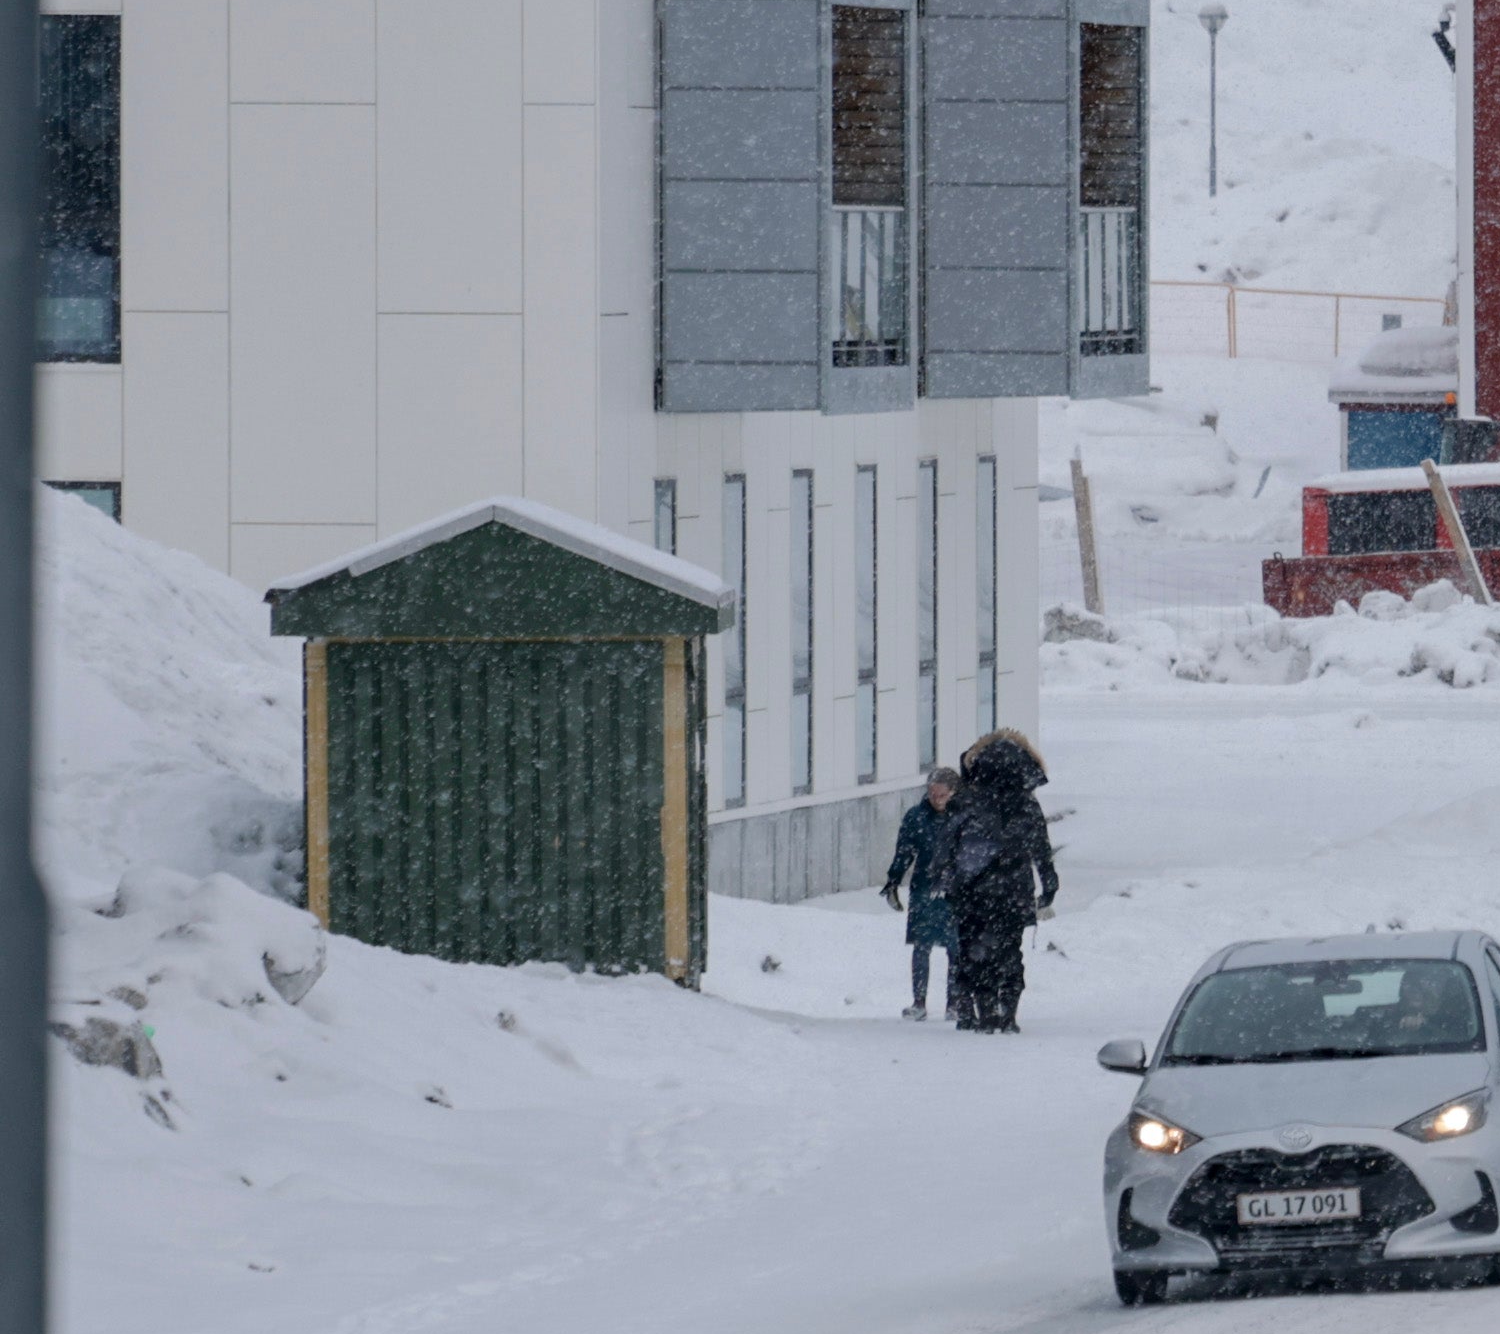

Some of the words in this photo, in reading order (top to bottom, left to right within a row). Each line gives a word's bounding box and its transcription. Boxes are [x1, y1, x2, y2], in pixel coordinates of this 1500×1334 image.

[1248, 1199, 1276, 1218] GL
[1283, 1195, 1306, 1216] 17
[1312, 1193, 1348, 1213] 091
